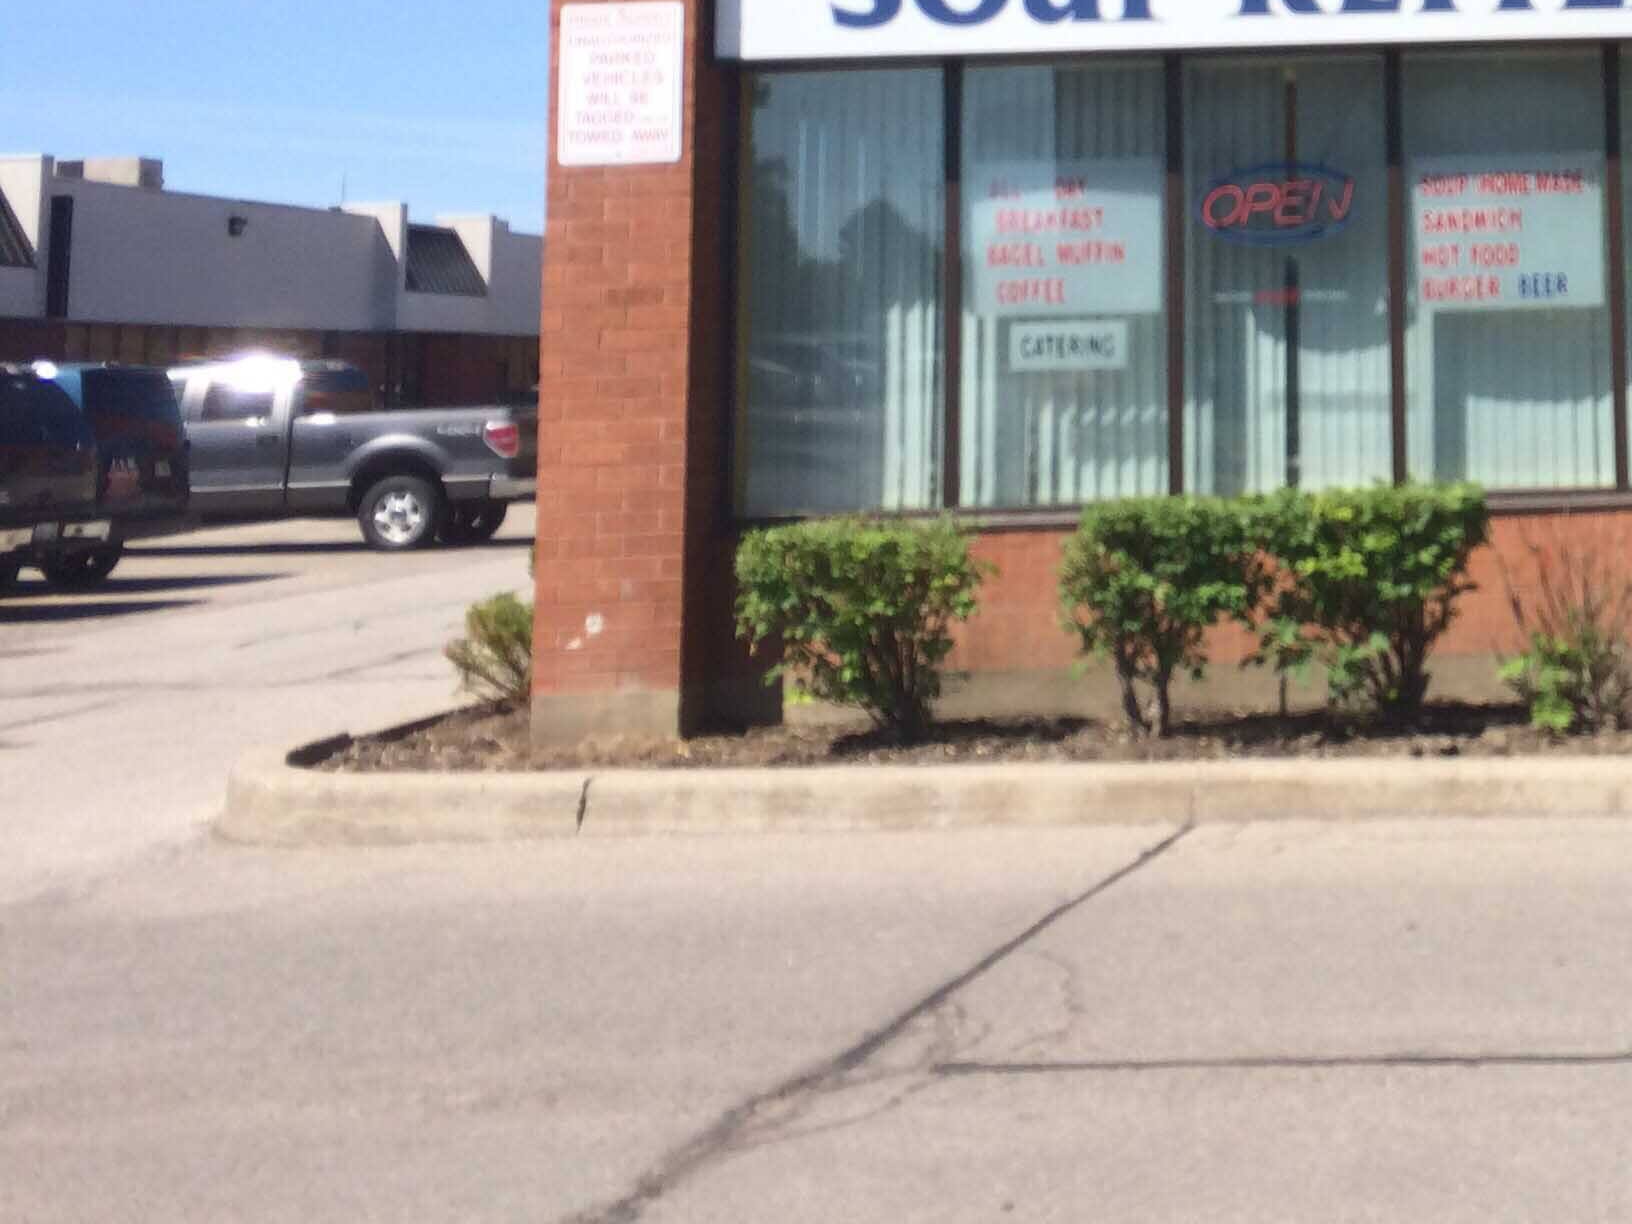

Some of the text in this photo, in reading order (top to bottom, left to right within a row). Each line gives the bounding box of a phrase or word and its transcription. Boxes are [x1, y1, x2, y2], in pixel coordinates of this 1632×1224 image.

[1201, 178, 1354, 228] OPEN
[1422, 207, 1523, 234] SANDWICH
[995, 278, 1066, 305] COFFEE
[1517, 271, 1570, 299] BEER
[1020, 332, 1116, 358] CATERING
